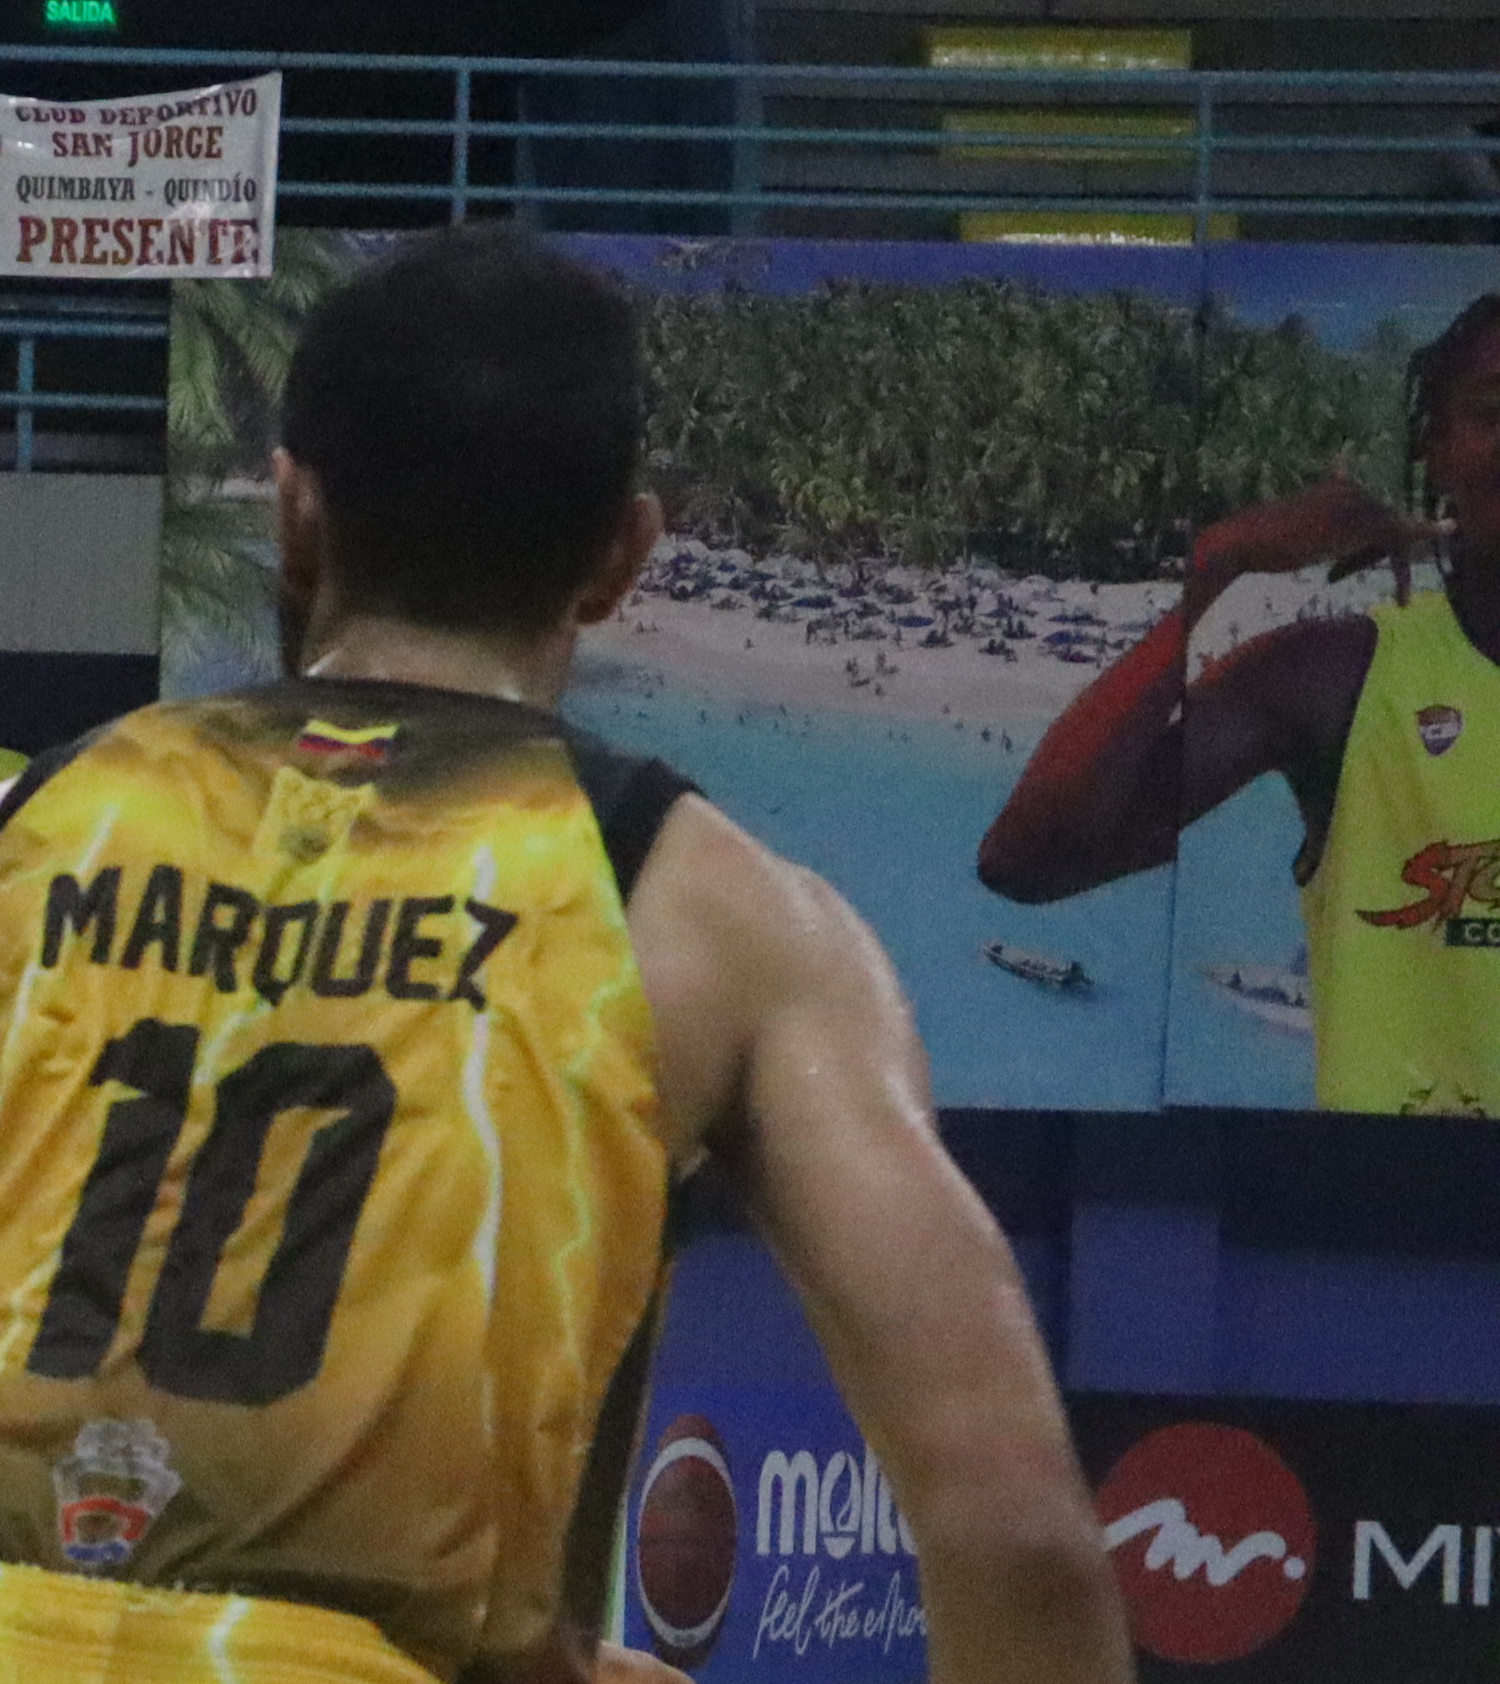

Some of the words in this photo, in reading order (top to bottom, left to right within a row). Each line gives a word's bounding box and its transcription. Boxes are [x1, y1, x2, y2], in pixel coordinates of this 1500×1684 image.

[46, 1, 116, 23] SALIDA
[100, 88, 257, 126] DEPORTIVO
[53, 131, 113, 158] SAN
[128, 126, 223, 167] JORGE
[16, 174, 135, 203] QUIMBAYA
[163, 172, 257, 205] QUINDÍO
[16, 216, 259, 266] PRESENTE
[38, 862, 520, 1012] MARQUEZ
[25, 1015, 398, 1408] 10
[753, 1564, 821, 1659] feel
[813, 1578, 865, 1649] the
